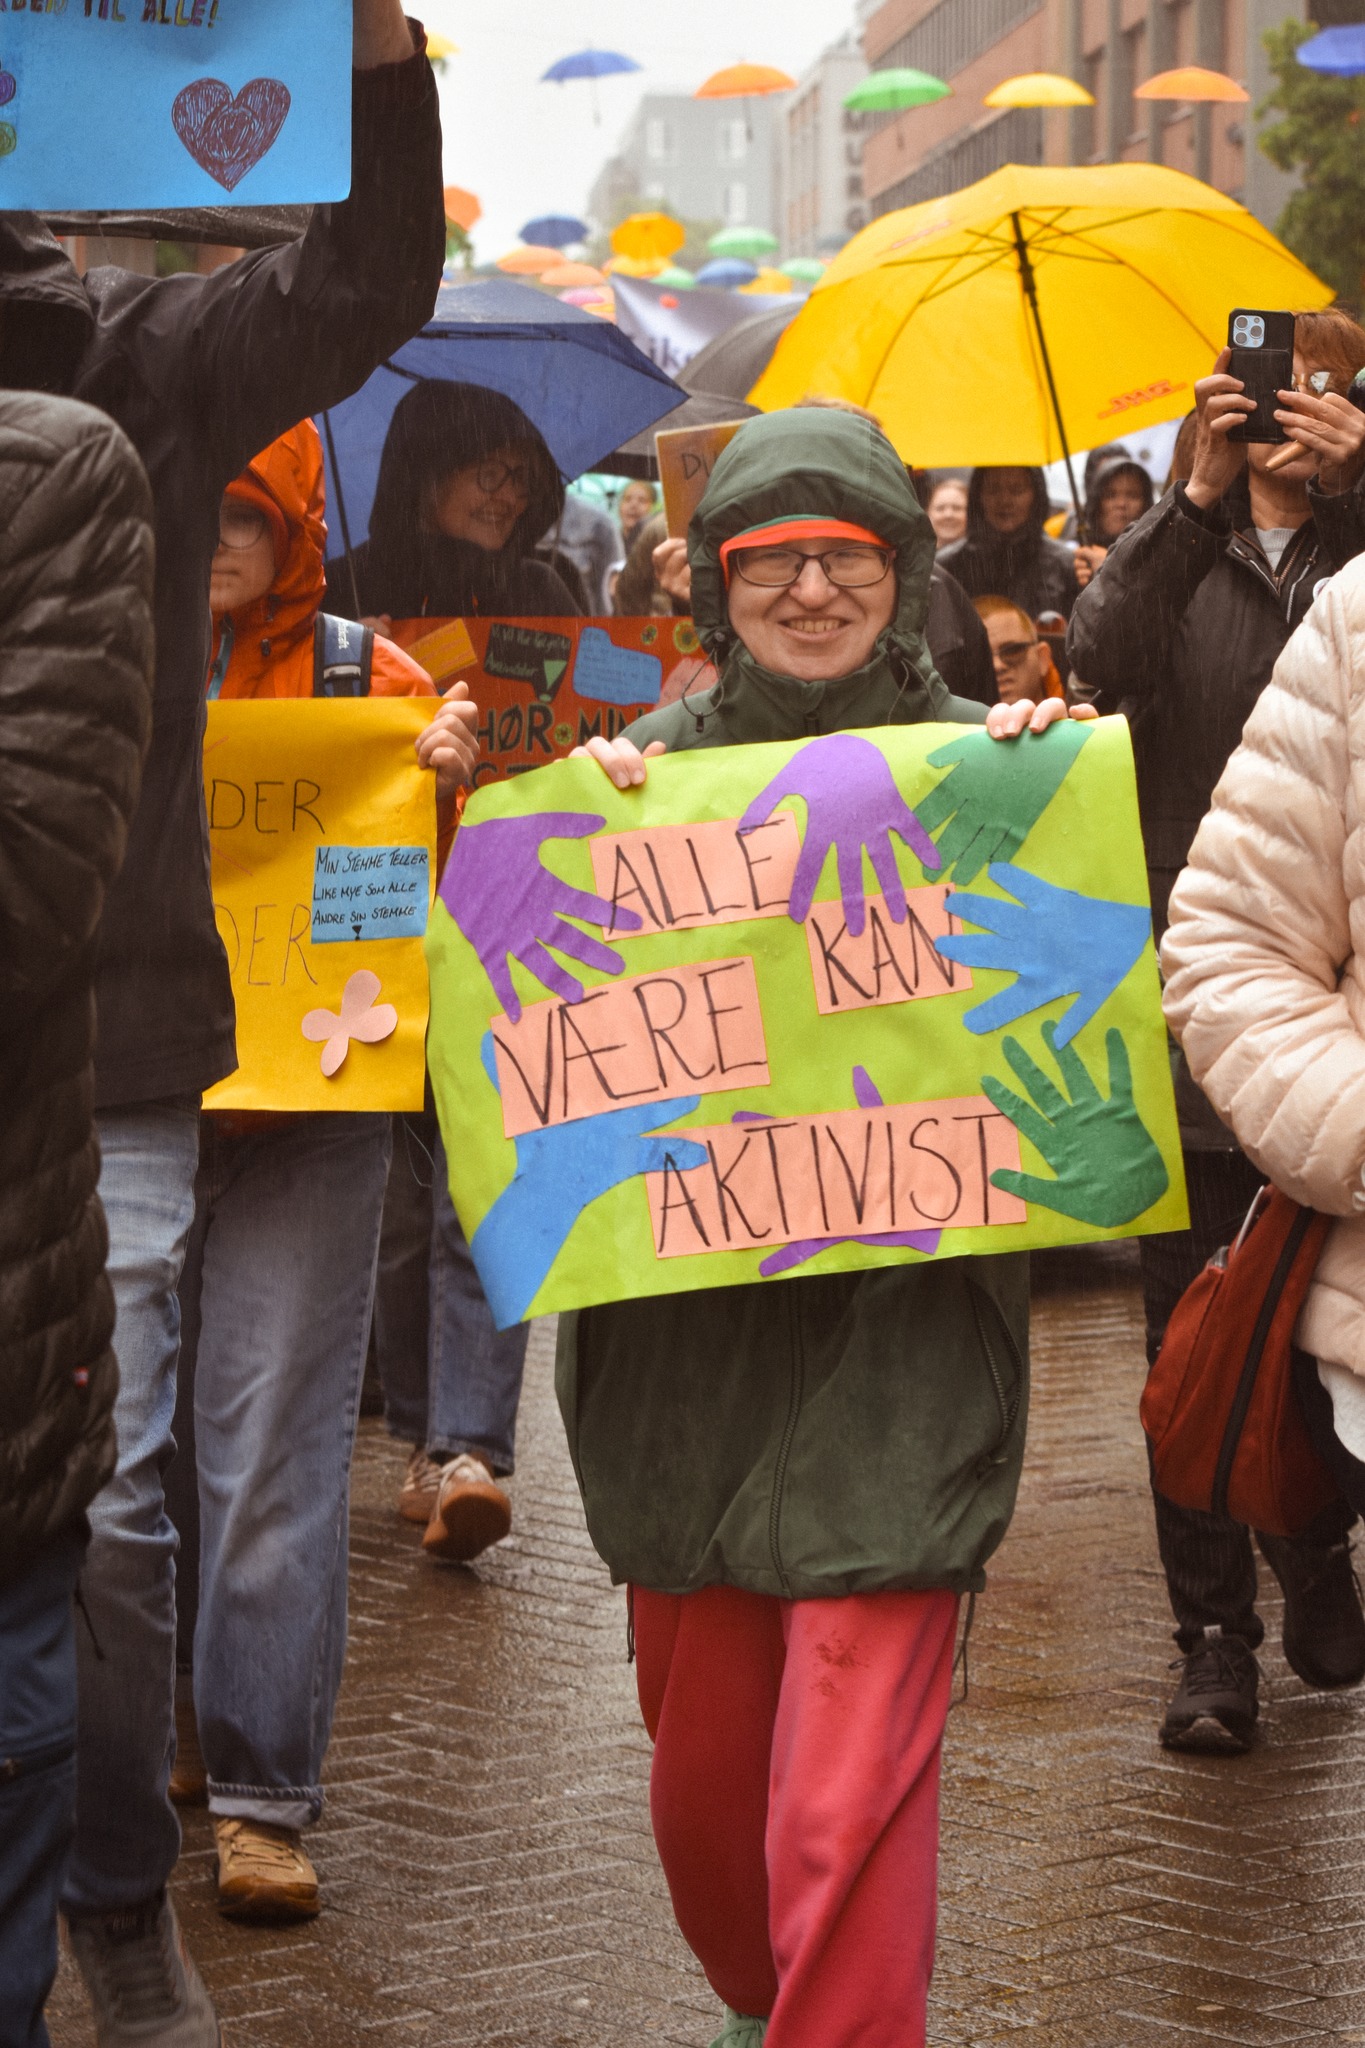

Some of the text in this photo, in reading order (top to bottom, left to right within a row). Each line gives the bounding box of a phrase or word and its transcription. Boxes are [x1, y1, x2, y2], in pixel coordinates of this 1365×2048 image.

[312, 905, 417, 926] ANDRE SIN STEMME
[388, 881, 418, 893] ALLE
[608, 818, 790, 935] ALLE
[810, 887, 955, 1006] KAN
[493, 960, 769, 1126] VÆRE
[658, 1112, 1006, 1254] AKTIVIST
